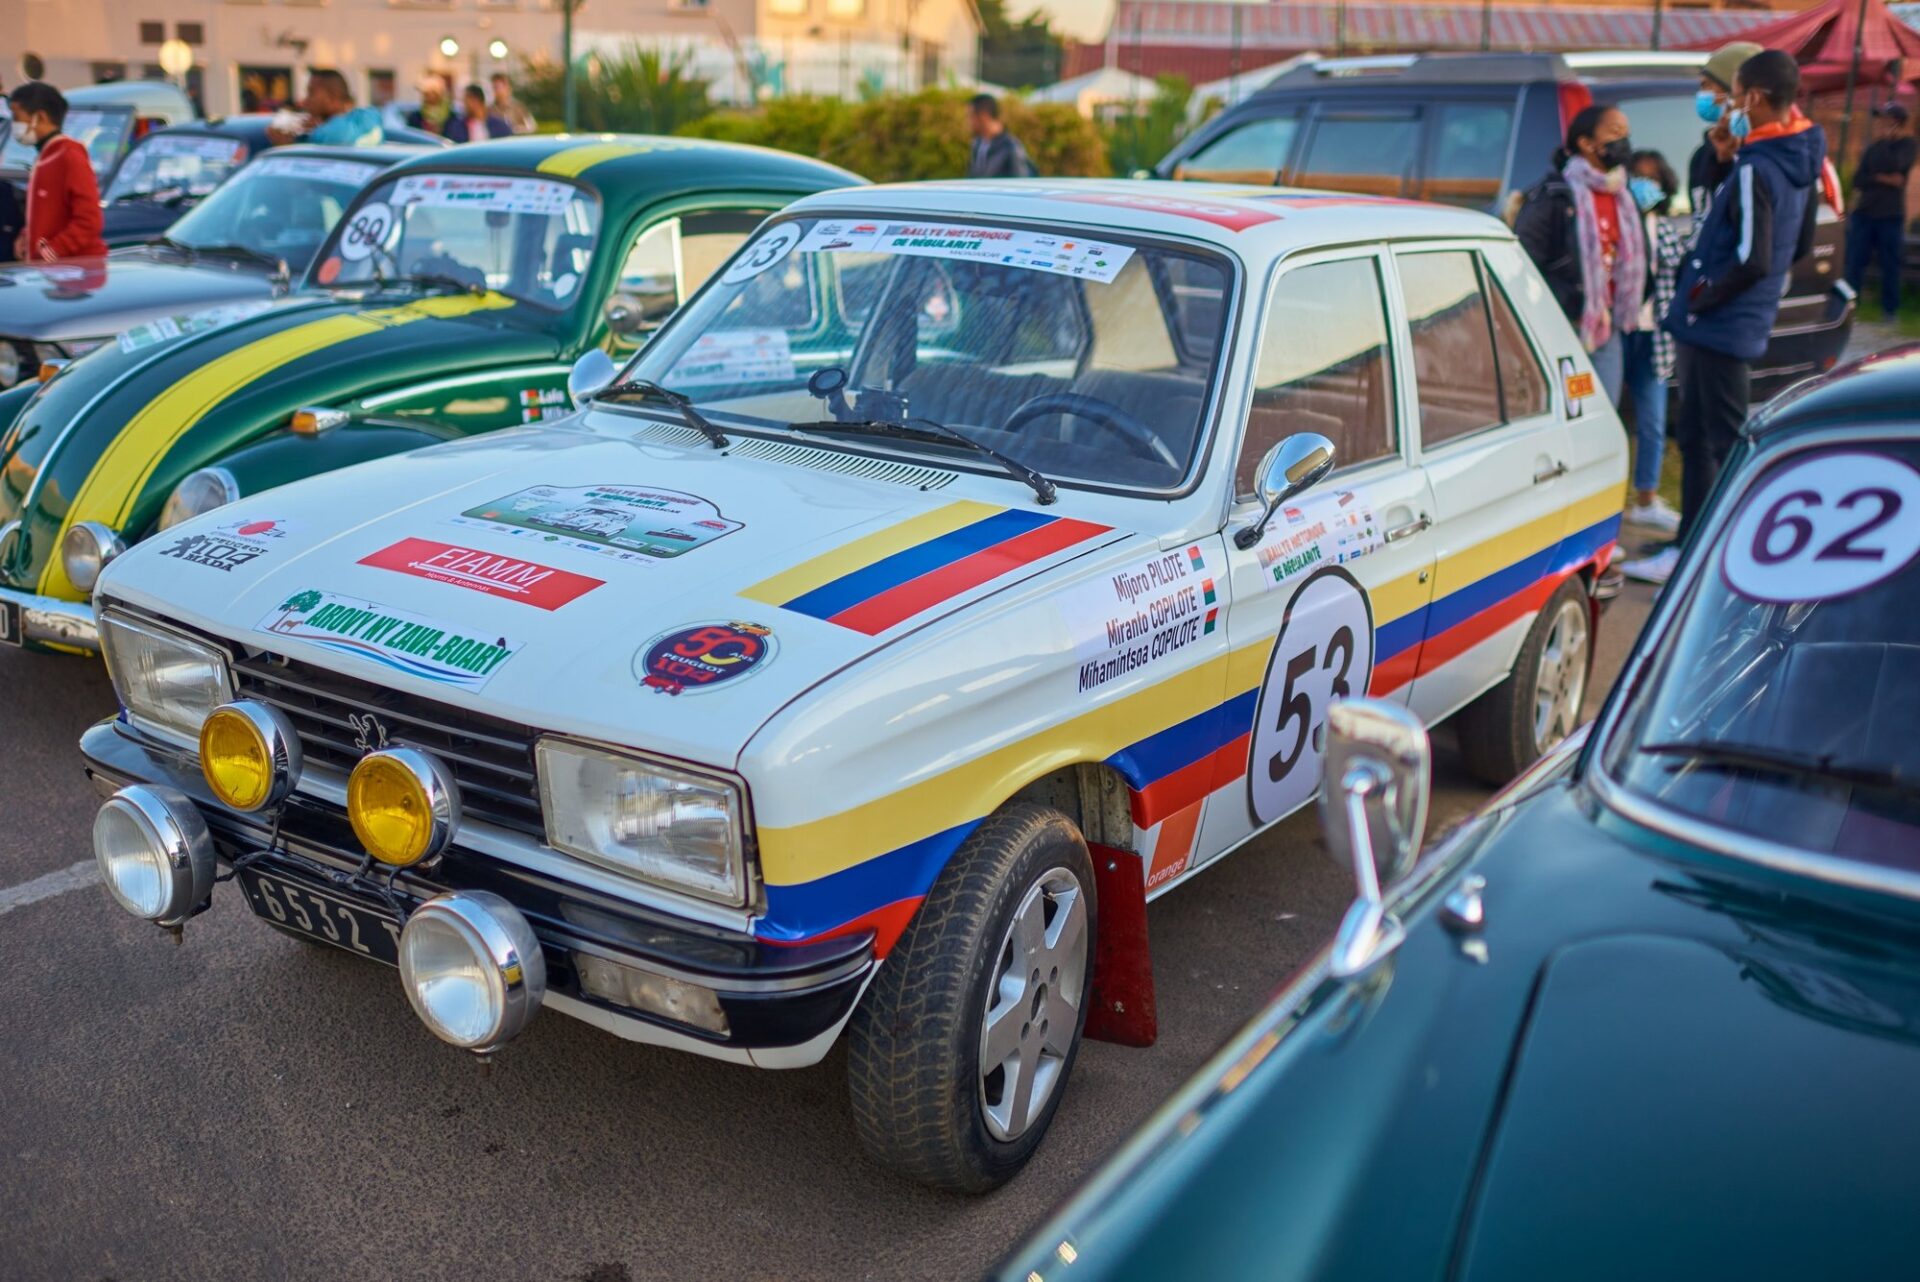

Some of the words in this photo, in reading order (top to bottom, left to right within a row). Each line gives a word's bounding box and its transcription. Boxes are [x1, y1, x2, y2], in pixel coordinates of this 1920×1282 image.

[892, 238, 909, 247] DE
[1752, 484, 1903, 567] 62
[181, 553, 234, 572] MADA
[425, 548, 555, 588] FIAMM
[1112, 573, 1150, 604] Mijoro
[1147, 553, 1186, 588] PILOTE
[1272, 565, 1284, 582] DE
[303, 602, 379, 637] AROVY
[360, 613, 404, 643] NY
[384, 622, 513, 676] ZAVA-BOARY
[1106, 611, 1149, 648] Miranto
[1149, 586, 1198, 629] COPILOTE
[662, 652, 726, 674] PEUGEOT
[728, 652, 755, 663] ANS
[1078, 644, 1149, 693] Mihamintsoa
[1151, 615, 1200, 661] COPILOTE
[1268, 625, 1355, 783] 53
[1147, 858, 1185, 887] orange
[257, 877, 371, 954] 6532
